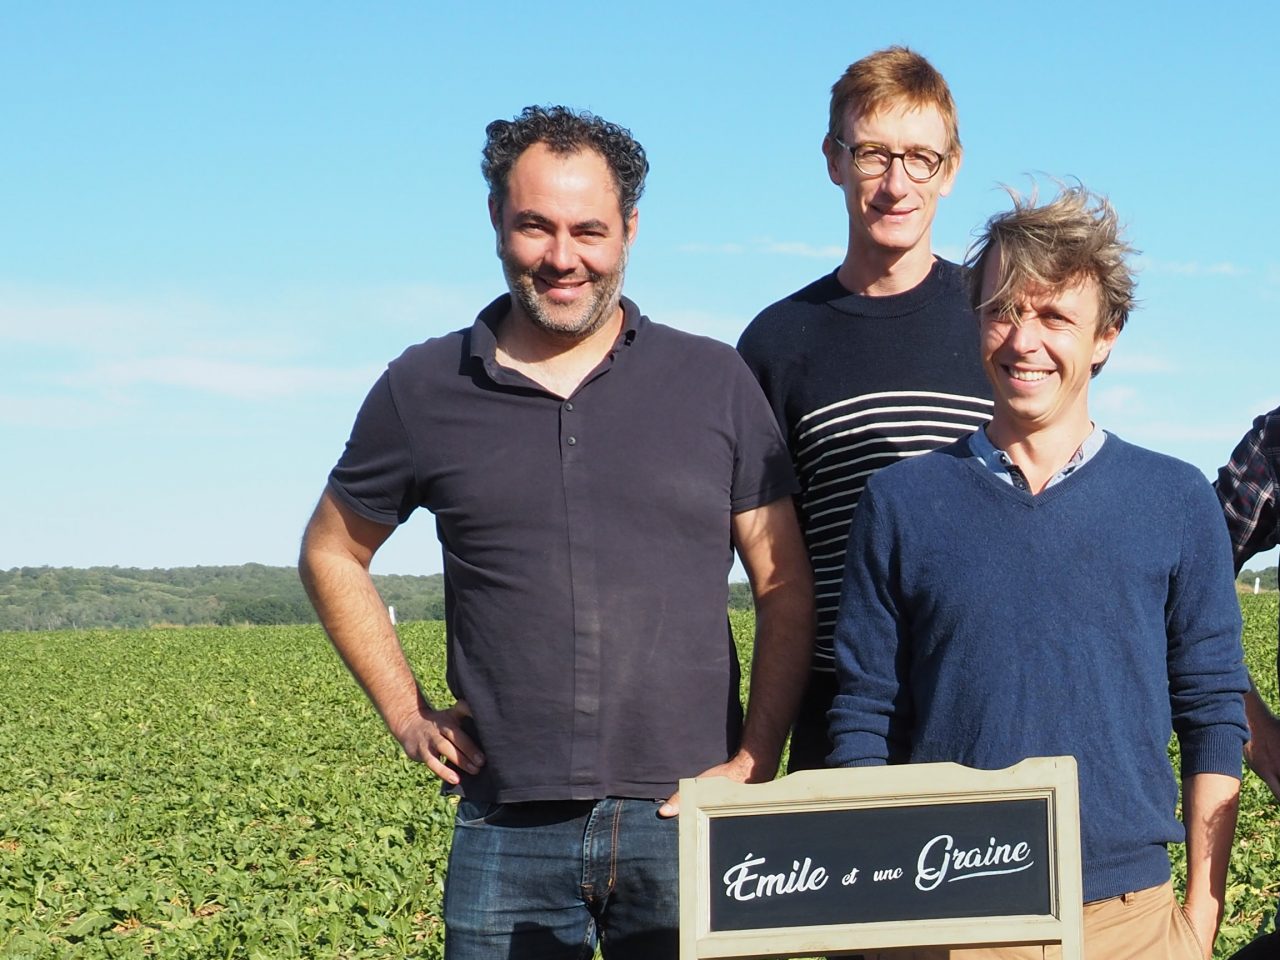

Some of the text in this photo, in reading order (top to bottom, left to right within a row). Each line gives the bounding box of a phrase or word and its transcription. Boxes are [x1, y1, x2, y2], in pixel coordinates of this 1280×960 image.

[723, 834, 1034, 901] Émile et une Graine
